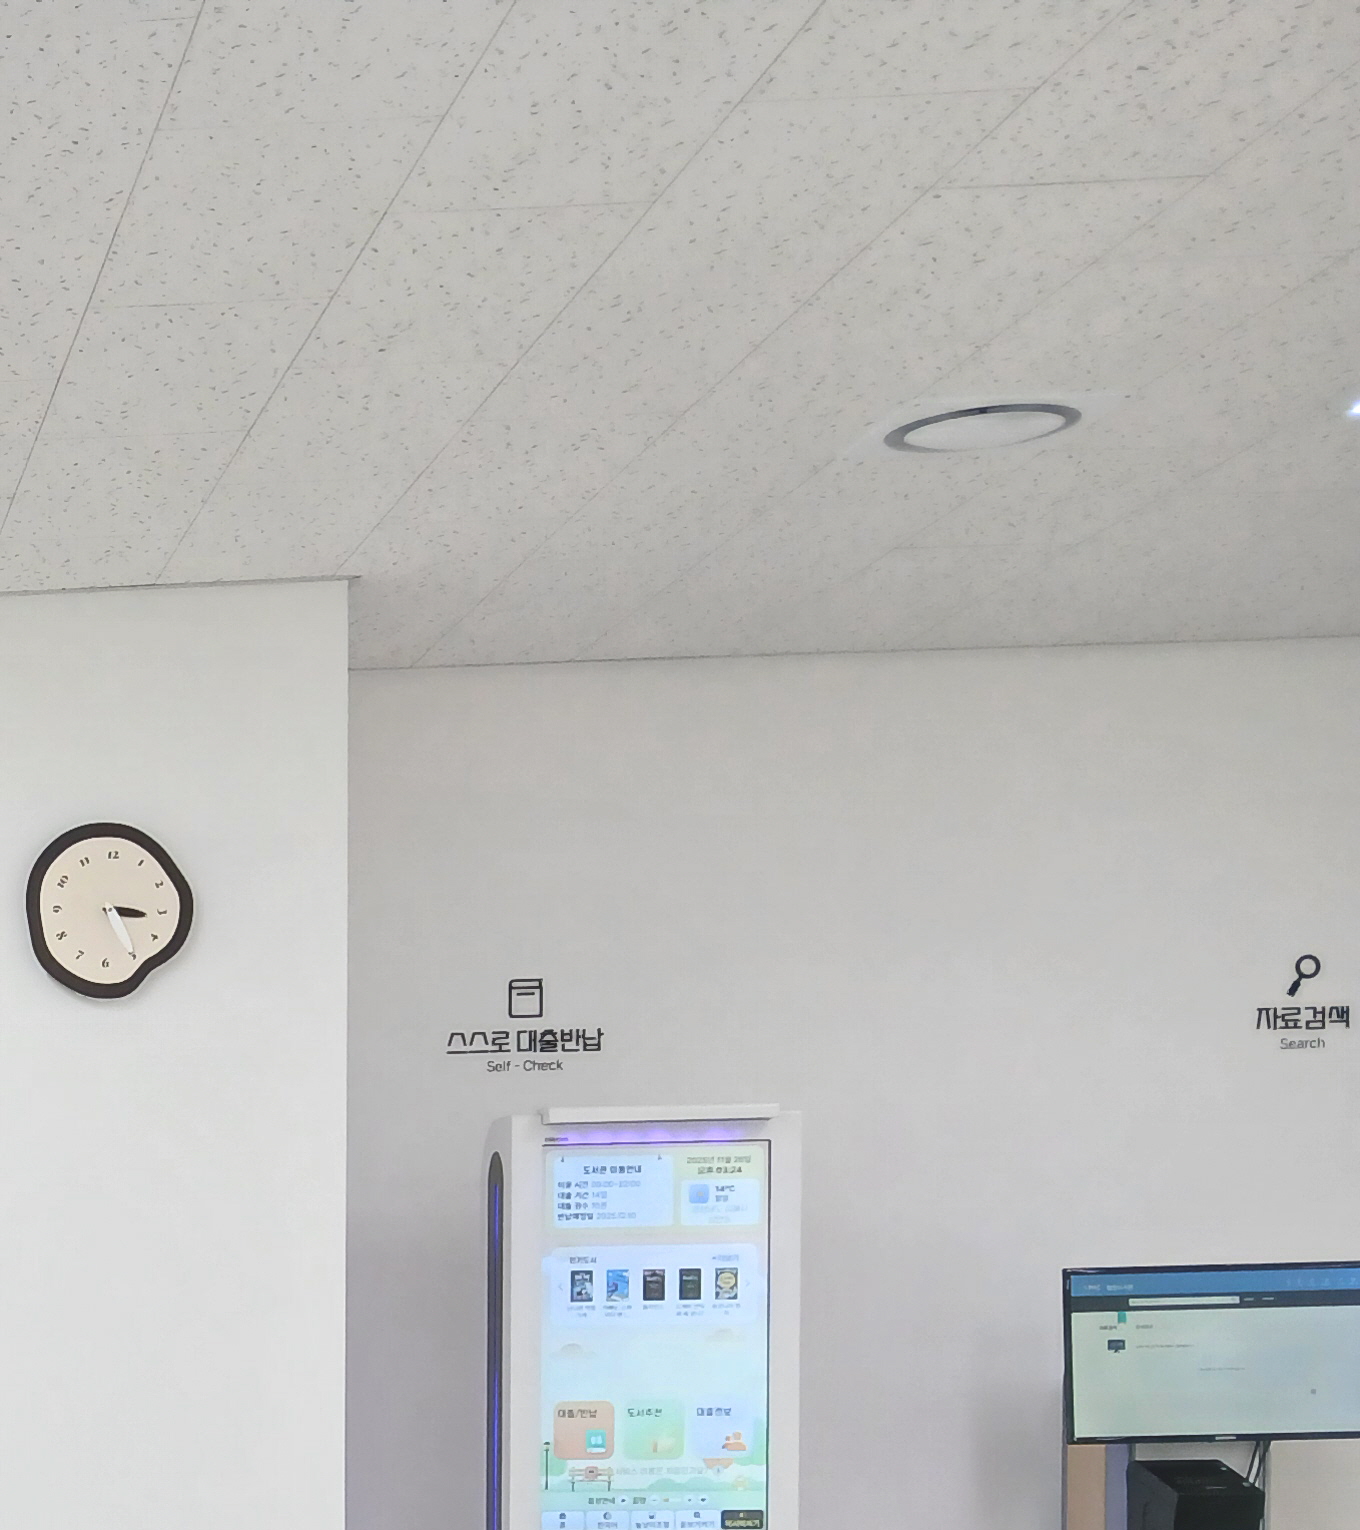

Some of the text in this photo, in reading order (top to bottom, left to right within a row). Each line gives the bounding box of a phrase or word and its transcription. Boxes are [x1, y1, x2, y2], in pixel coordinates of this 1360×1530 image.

[1256, 1006, 1351, 1030] 자료검색
[446, 1028, 605, 1054] 스스로 대출반납
[1280, 1037, 1326, 1050] Search
[486, 1059, 564, 1073] Self Check
